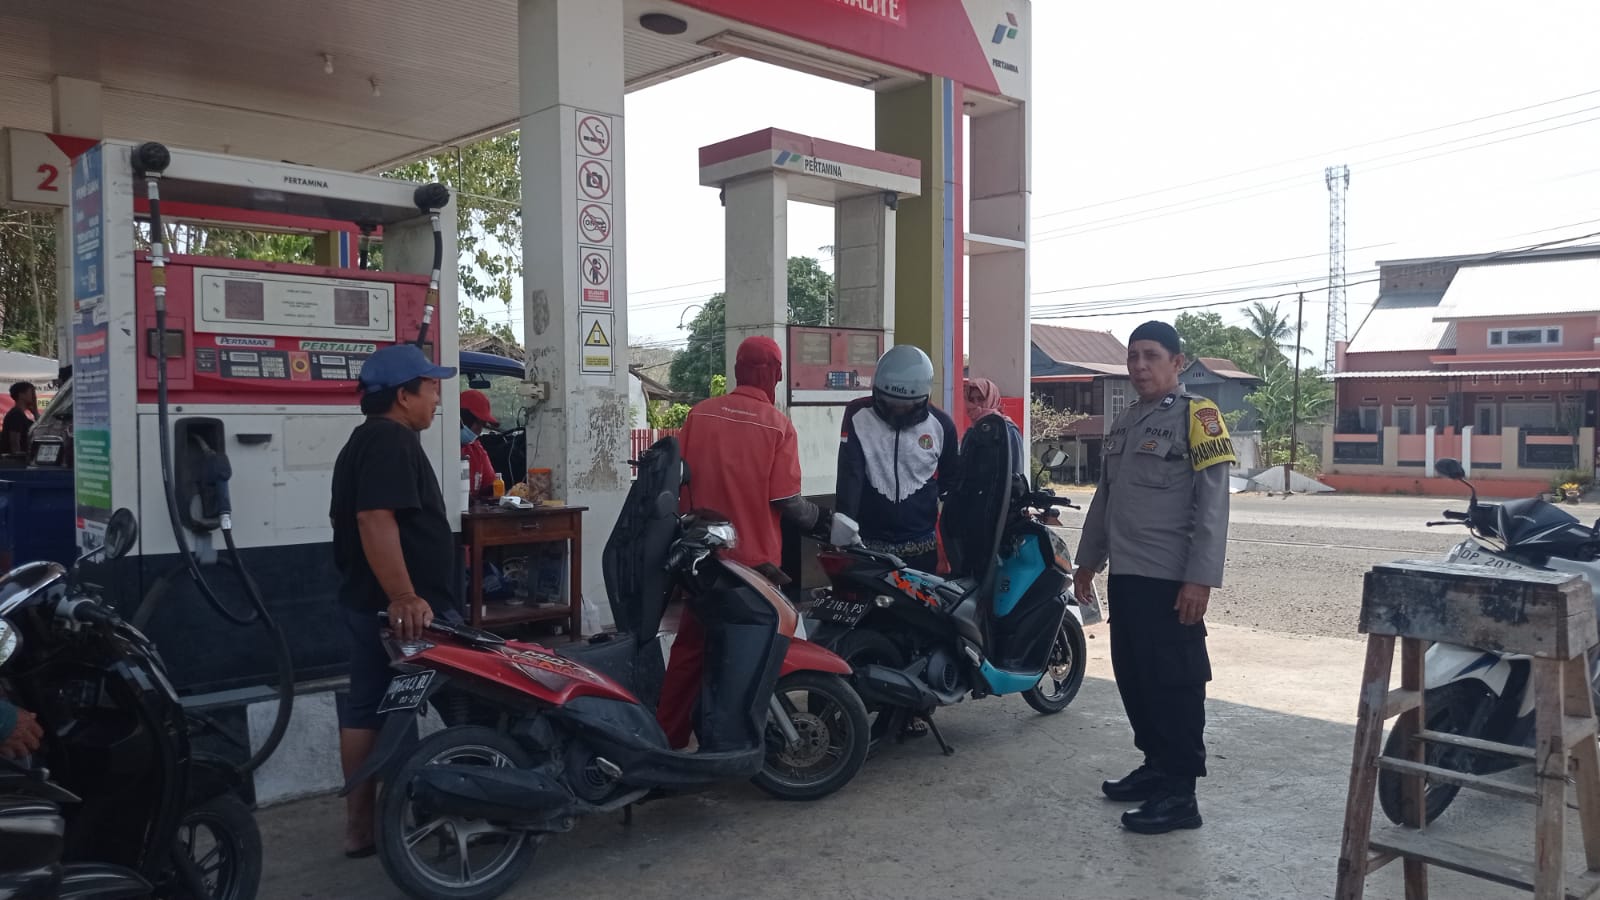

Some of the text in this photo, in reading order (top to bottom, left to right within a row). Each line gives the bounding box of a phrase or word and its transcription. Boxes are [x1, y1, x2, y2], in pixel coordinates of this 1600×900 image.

[992, 58, 1019, 74] PERTAMINA
[804, 158, 843, 178] PERTAMINA
[36, 163, 59, 192] 2
[283, 175, 329, 189] PERTAMINA
[220, 336, 268, 346] PERTAMAX
[300, 341, 375, 353] PERTALITE
[1145, 426, 1173, 439] POLRI
[1460, 548, 1480, 561] DP
[851, 603, 865, 614] PS
